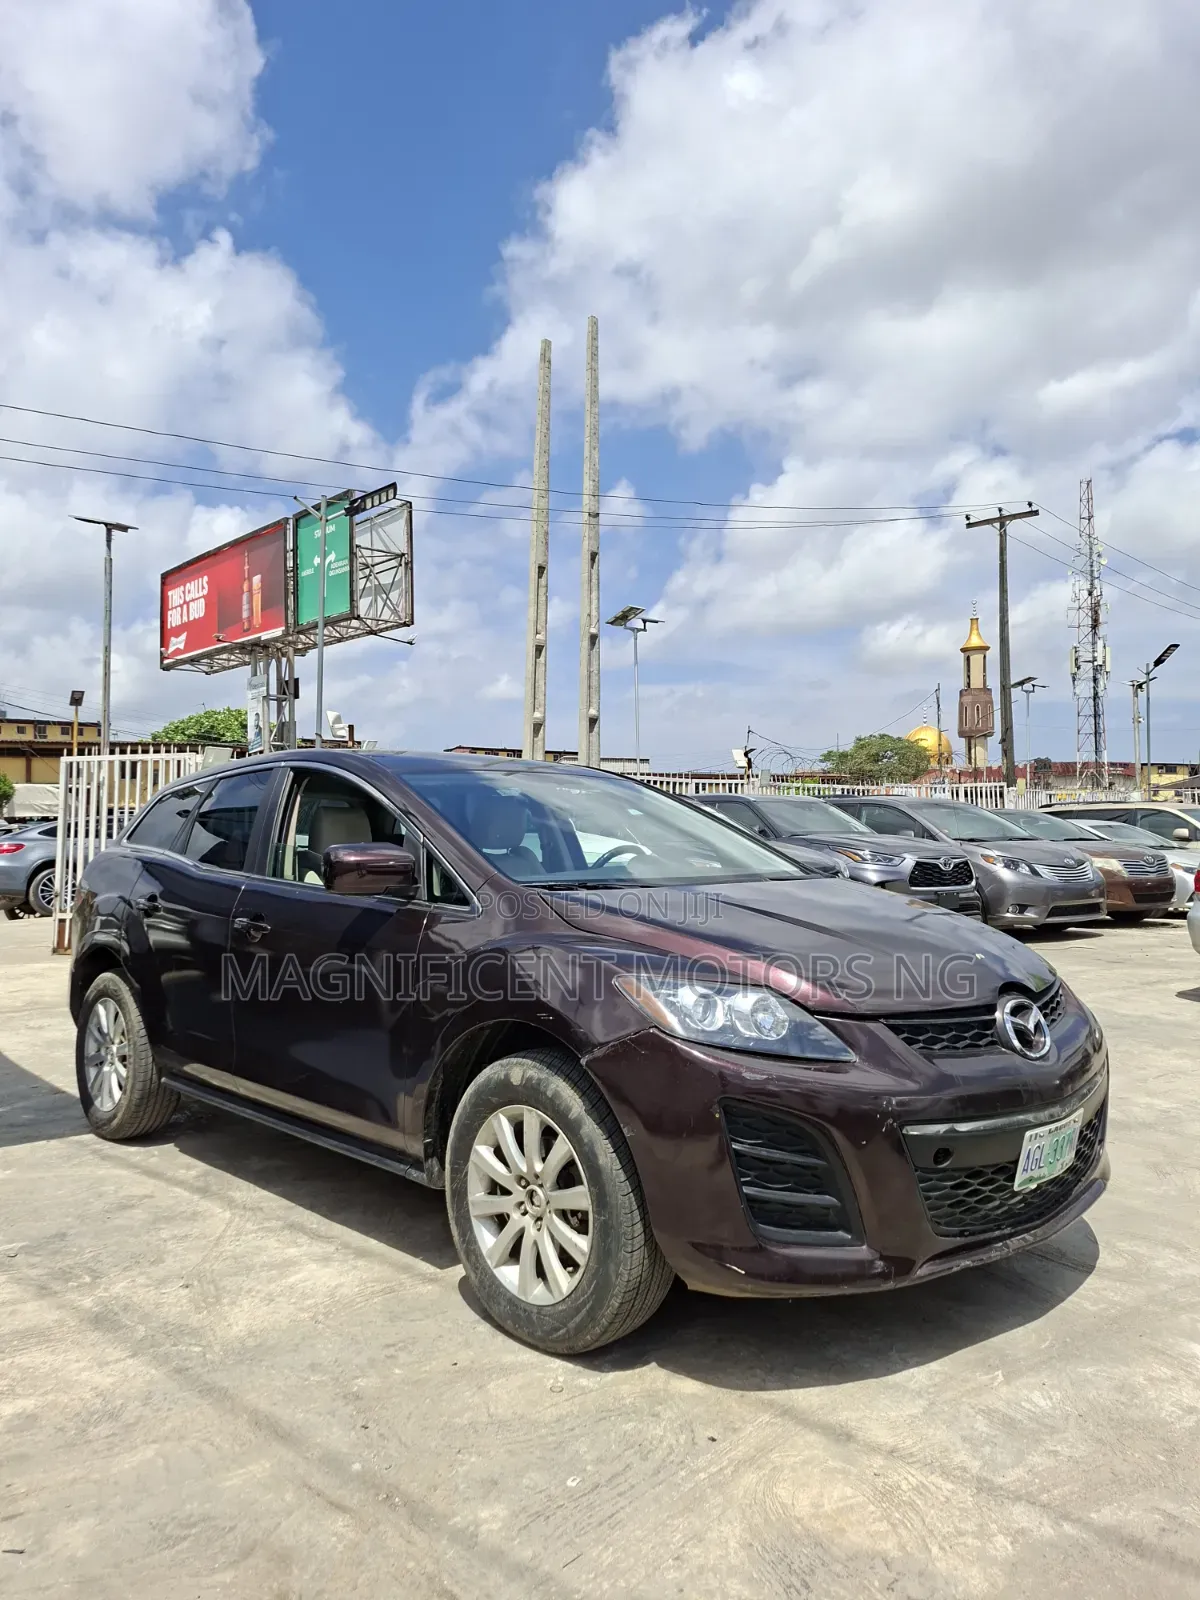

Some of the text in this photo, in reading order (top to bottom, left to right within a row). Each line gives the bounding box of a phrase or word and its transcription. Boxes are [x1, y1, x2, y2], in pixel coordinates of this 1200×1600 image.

[167, 575, 209, 610] THIS CALLS
[167, 597, 206, 630] FOR A BUD
